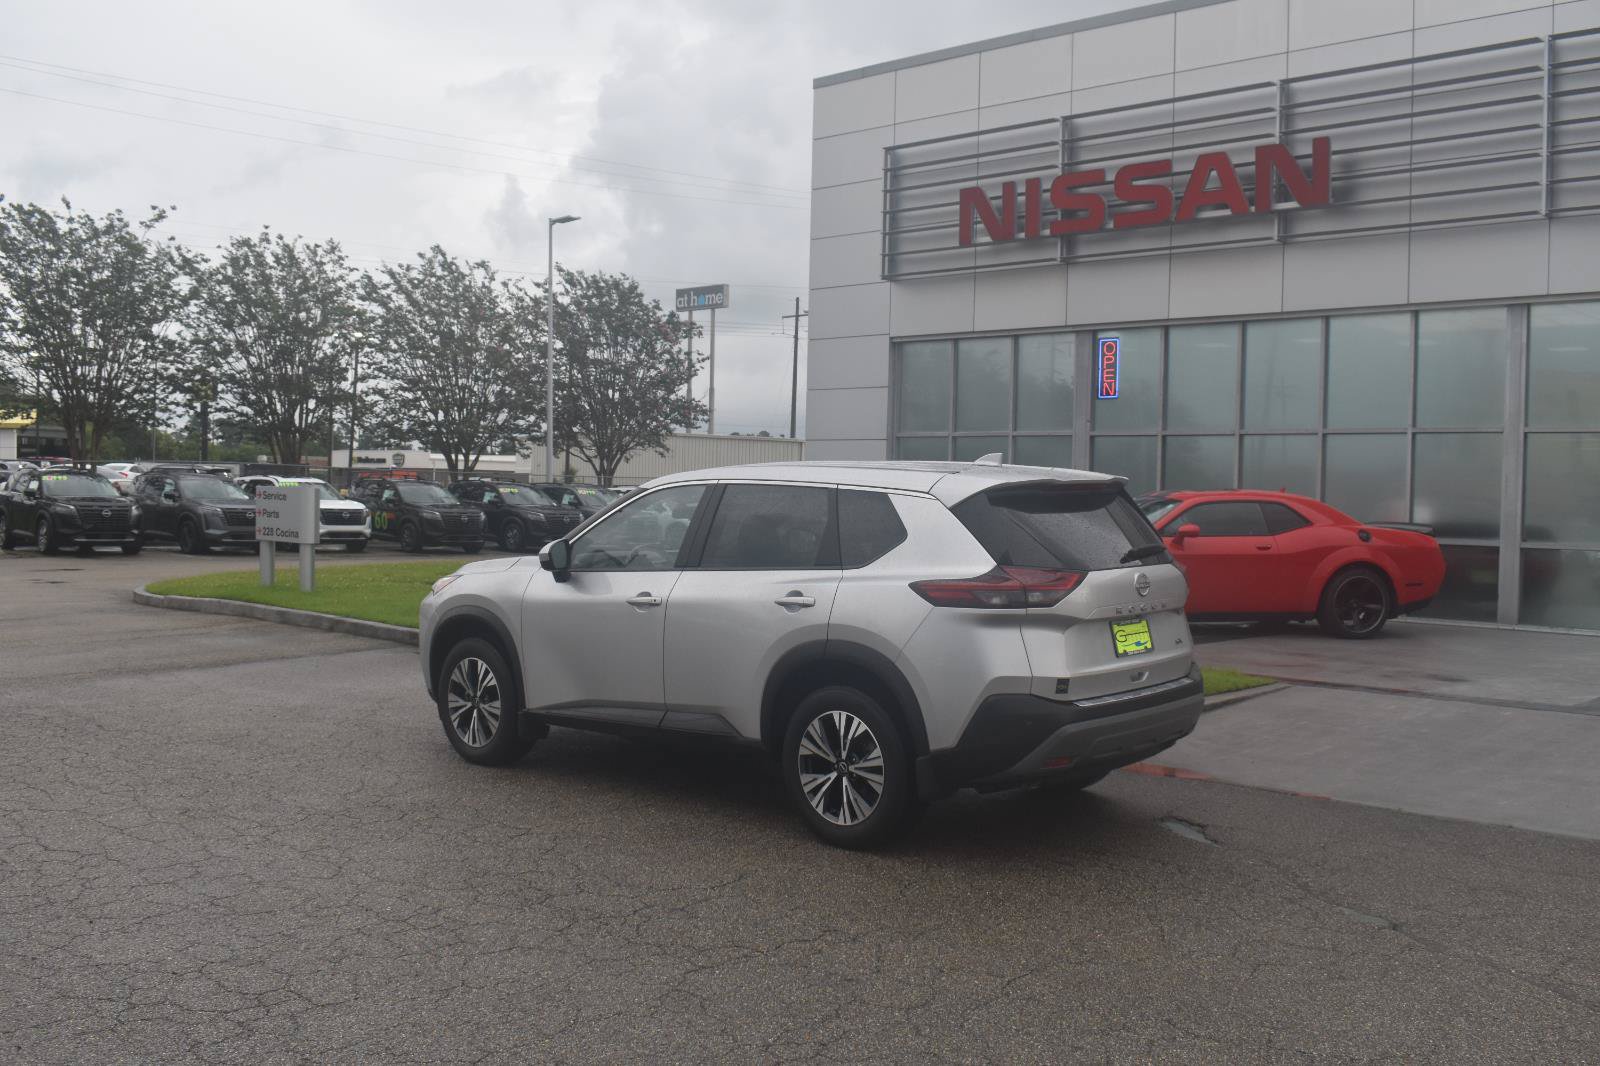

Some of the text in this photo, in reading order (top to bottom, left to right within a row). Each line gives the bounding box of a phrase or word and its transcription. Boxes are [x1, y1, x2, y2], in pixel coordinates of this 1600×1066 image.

[958, 136, 1331, 247] NISSAN
[676, 293, 688, 308] at
[1103, 341, 1116, 396] OPEN
[262, 490, 287, 501] Service
[262, 508, 280, 519] Parts
[262, 526, 300, 538] 228 Cocina
